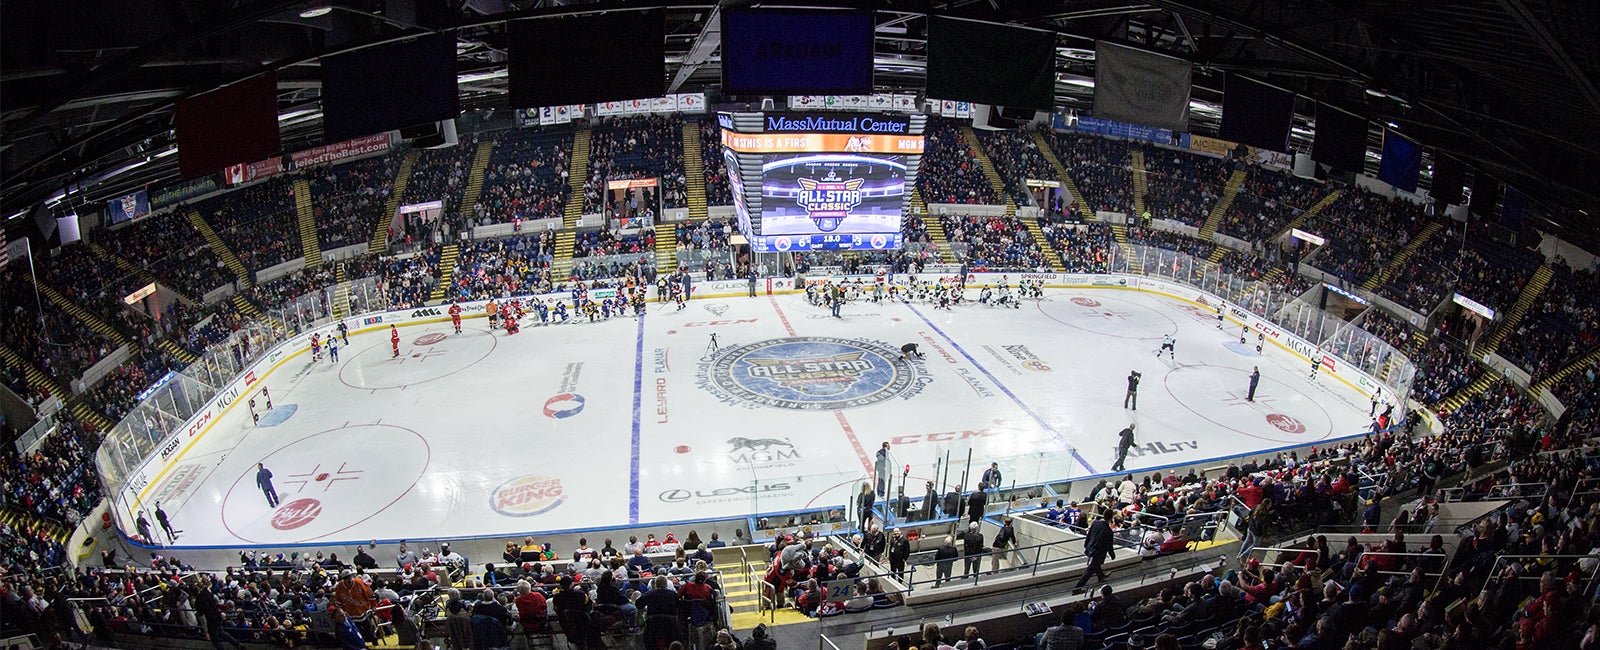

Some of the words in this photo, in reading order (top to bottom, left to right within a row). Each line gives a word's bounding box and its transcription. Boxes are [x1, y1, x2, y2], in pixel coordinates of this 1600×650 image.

[543, 106, 551, 118] 2
[958, 102, 969, 112] 23
[767, 116, 857, 131] MassMutual
[860, 117, 906, 133] Center
[765, 138, 774, 148] IS
[776, 138, 782, 148] A
[784, 138, 810, 148] FIRST
[898, 139, 916, 149] MGM
[807, 202, 851, 211] CLASSIC
[823, 235, 840, 243] 18.0
[1062, 274, 1089, 284] Fitzgerald
[1230, 307, 1248, 320] HOGAN
[683, 318, 759, 328] CCM
[1254, 321, 1281, 339] CCM
[1285, 337, 1312, 359] MGM
[654, 347, 666, 374] PLANAR
[917, 331, 958, 364] LEYARD
[957, 367, 995, 398] PLANAR
[1028, 359, 1052, 371] 99
[773, 370, 859, 382] CLASSIC
[900, 376, 934, 401] Center
[216, 387, 239, 414] MGM
[656, 377, 668, 424] LEYARD
[188, 410, 212, 437] CCM
[890, 428, 992, 446] CCM
[160, 437, 181, 459] HOGAN
[727, 449, 803, 463] MGM
[497, 478, 562, 499] BURGER
[695, 483, 791, 497] LEXUS
[496, 484, 564, 509] KING
[696, 495, 750, 505] EXPERIENCE
[831, 584, 850, 598] 24
